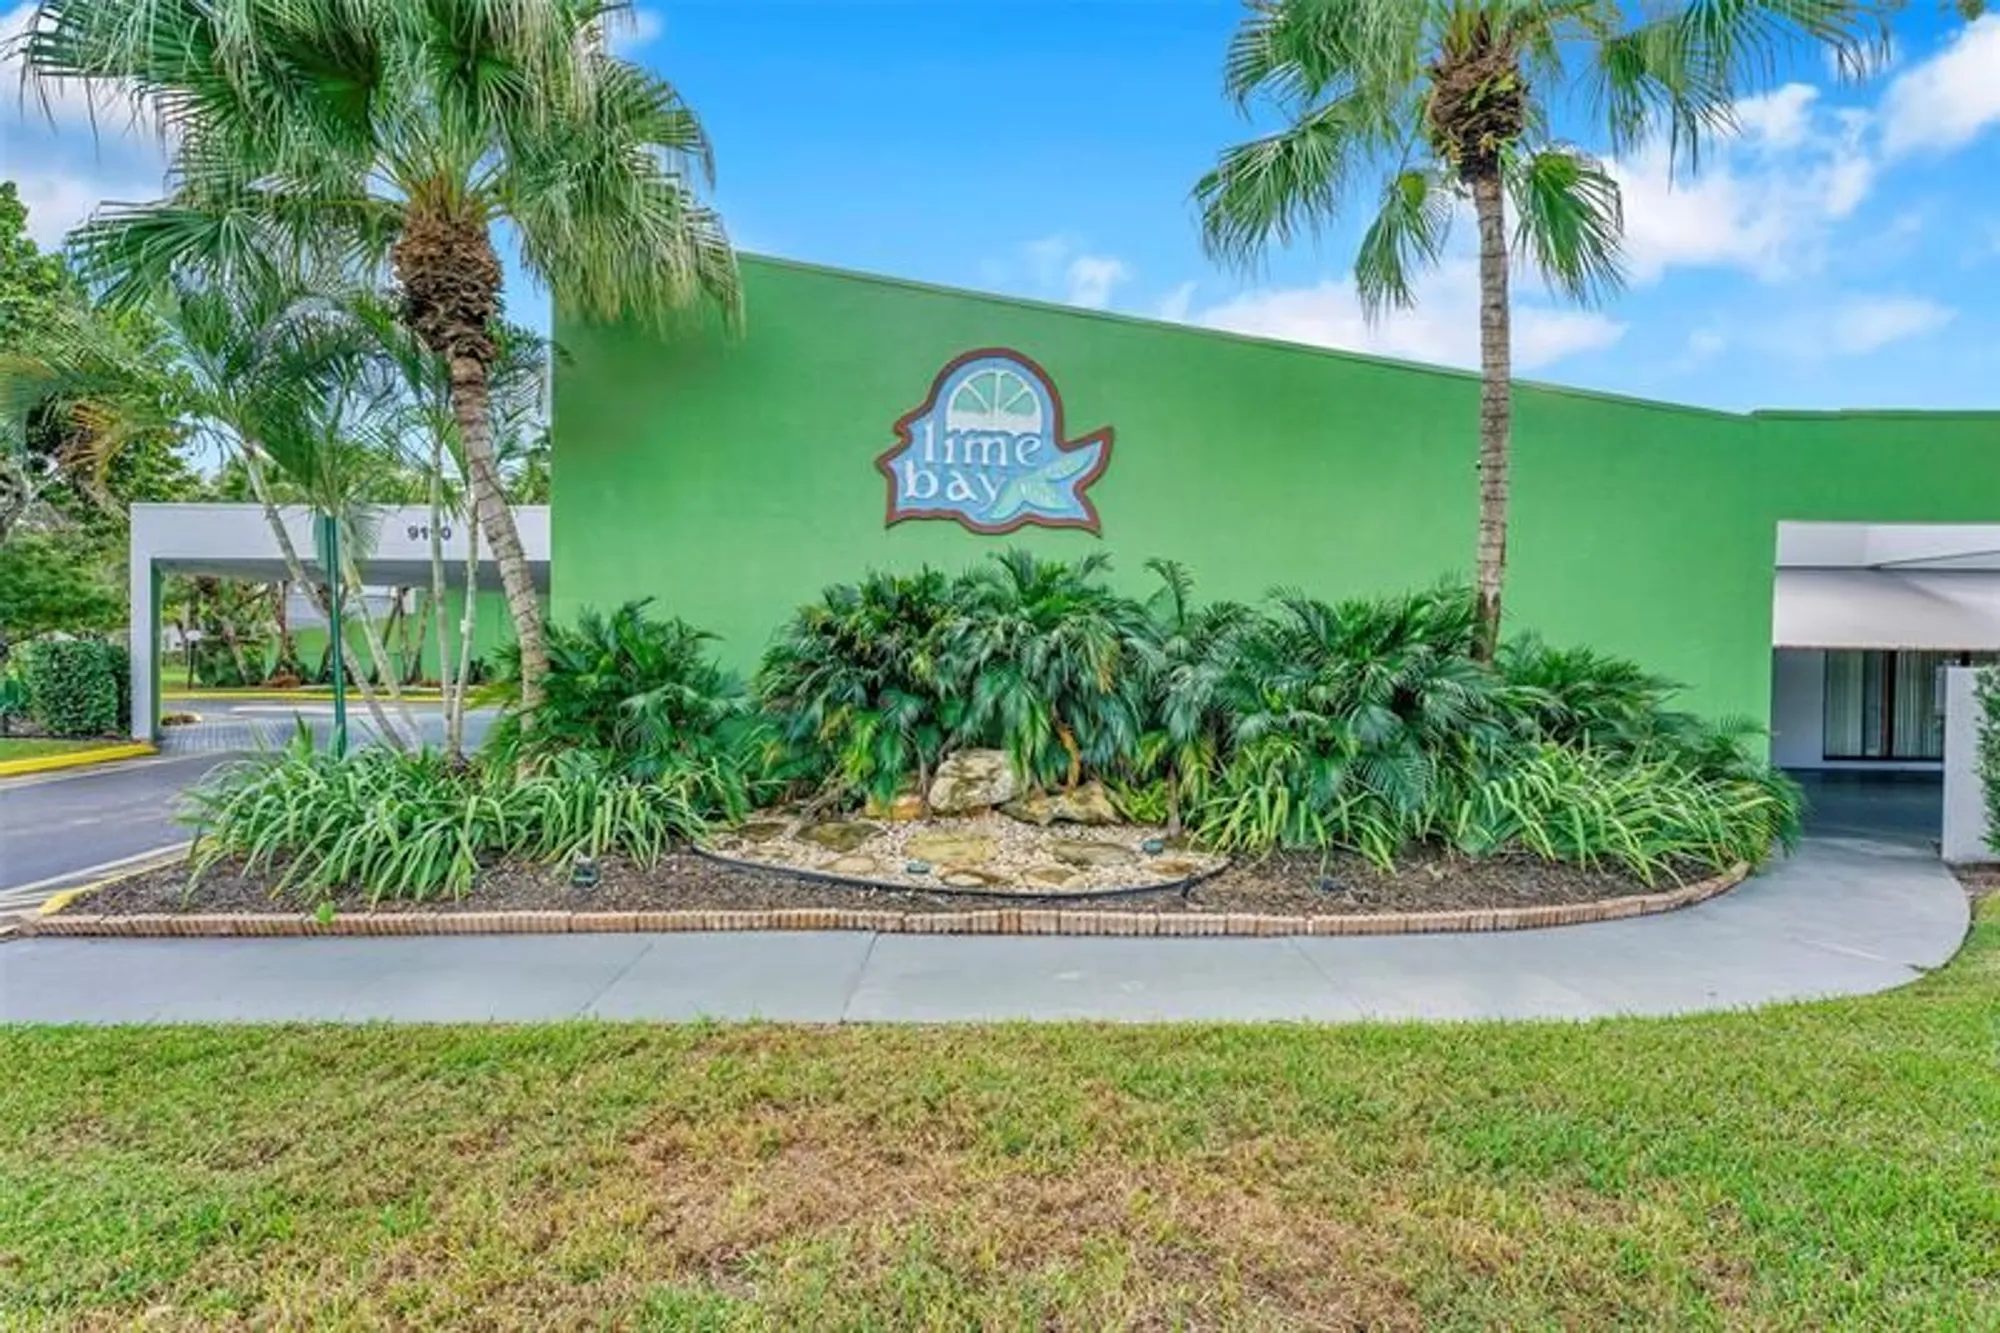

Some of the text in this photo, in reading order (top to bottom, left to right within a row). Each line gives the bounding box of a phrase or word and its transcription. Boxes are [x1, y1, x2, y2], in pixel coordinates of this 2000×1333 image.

[923, 421, 1042, 467] lime
[904, 459, 1006, 513] bay
[407, 525, 452, 541] 910
